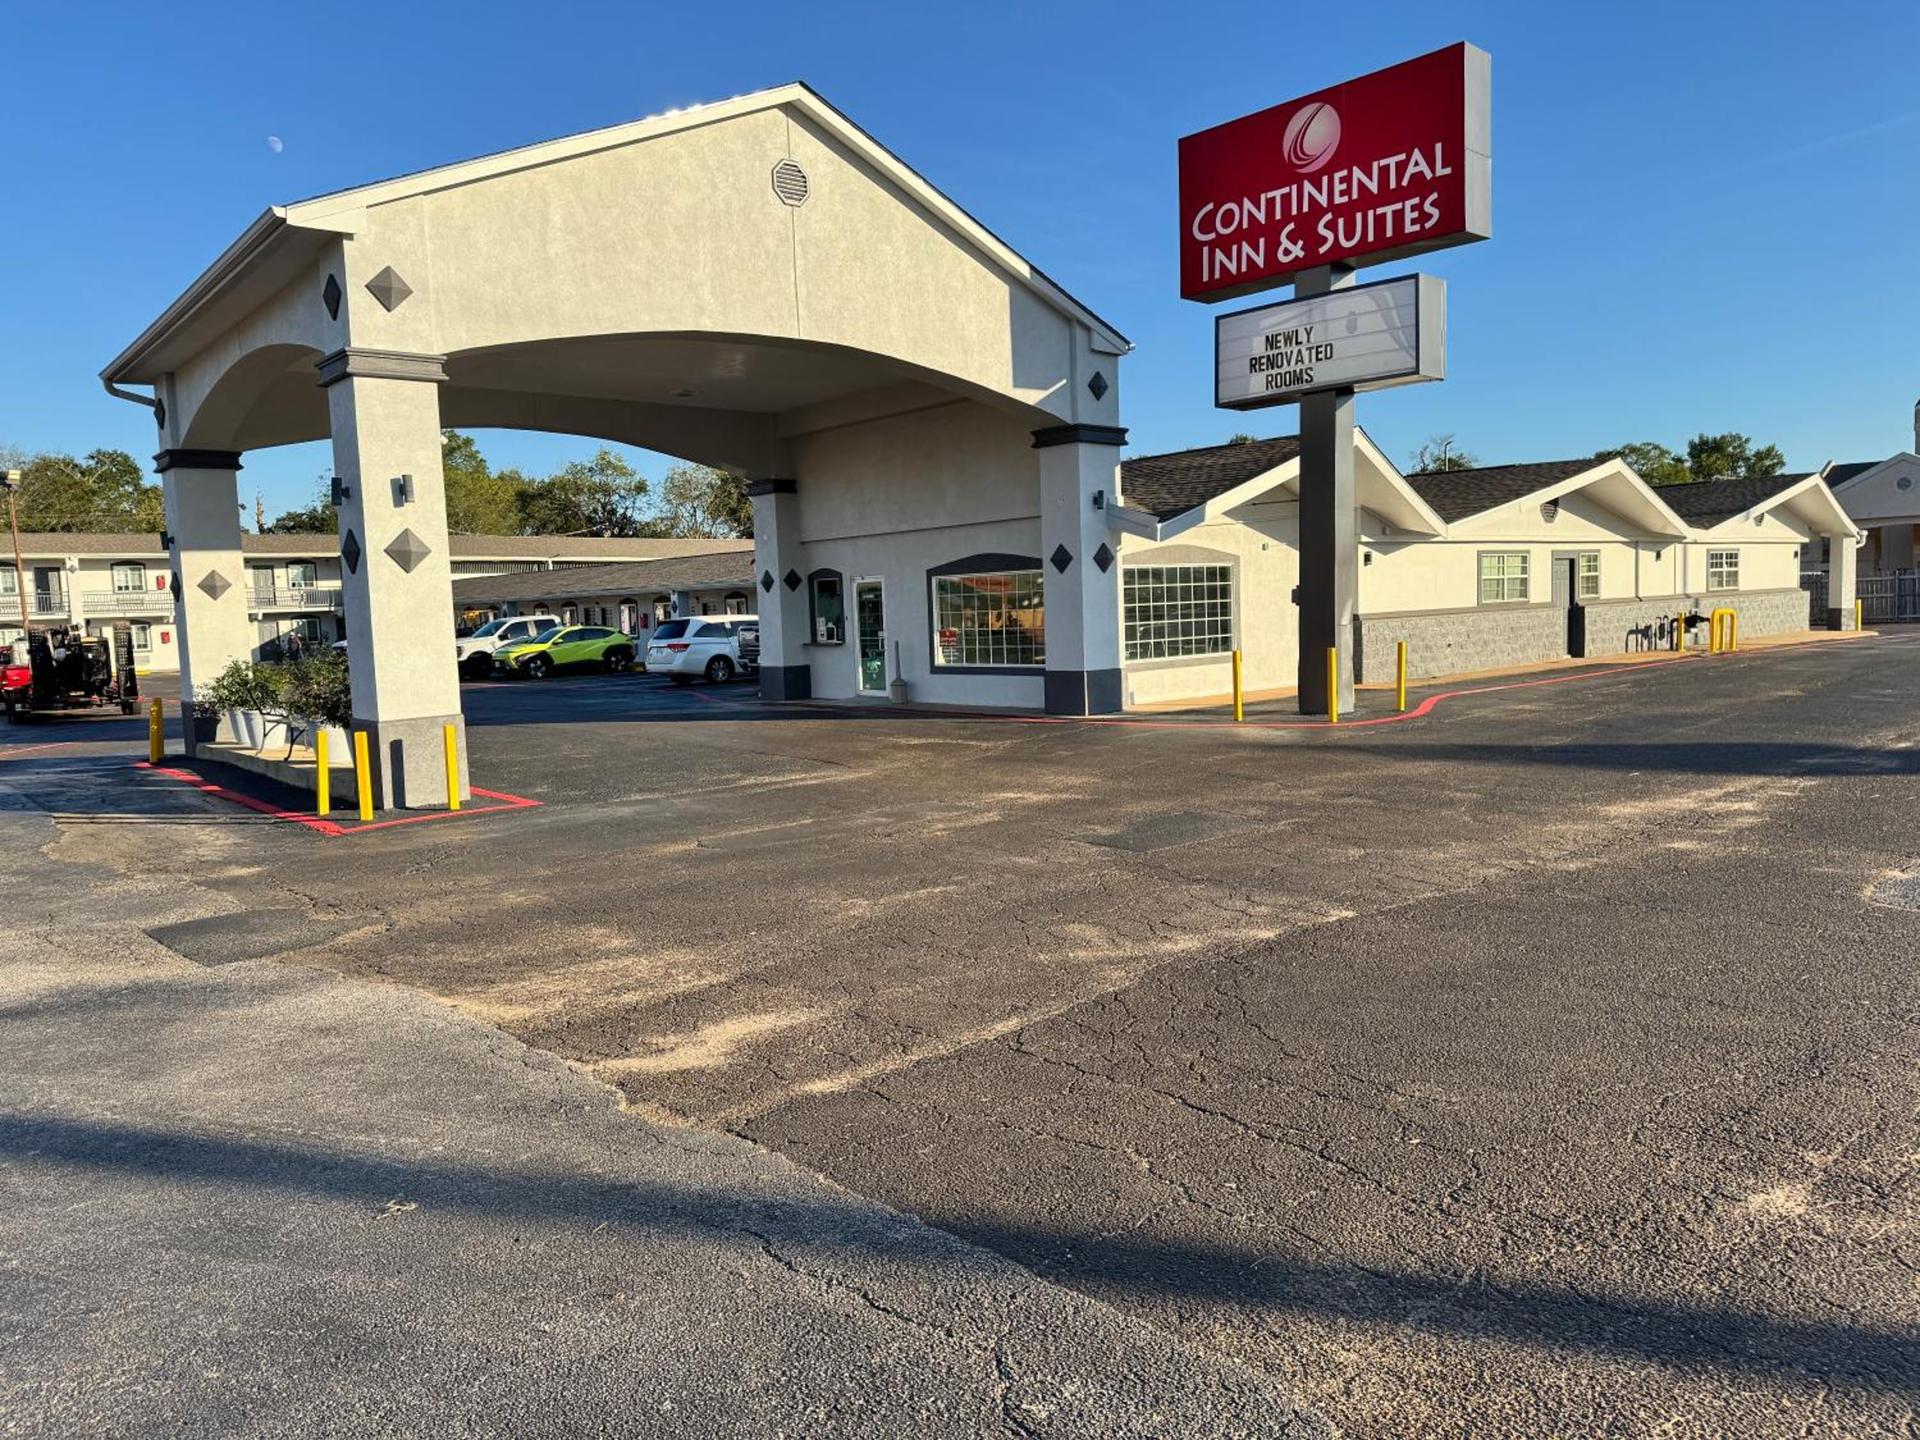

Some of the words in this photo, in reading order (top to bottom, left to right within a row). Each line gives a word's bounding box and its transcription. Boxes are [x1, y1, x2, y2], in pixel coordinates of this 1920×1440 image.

[1192, 142, 1452, 242] CONTINENTAL
[1203, 237, 1265, 283] INN
[1276, 222, 1305, 264] &
[1317, 192, 1440, 255] SUITES
[1265, 326, 1314, 351] NEWLY
[1249, 343, 1334, 374] RENOVATED
[1265, 367, 1314, 391] ROOMS
